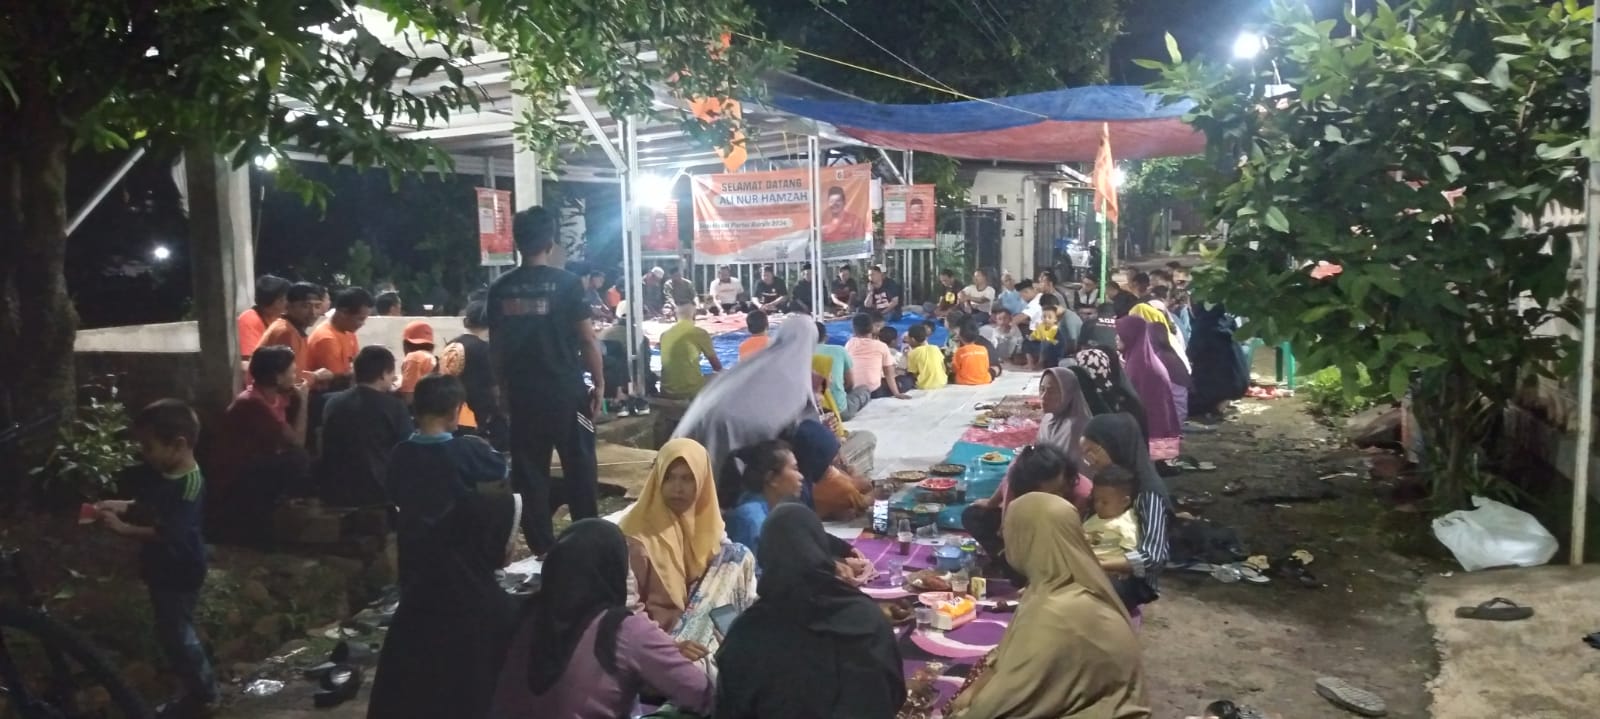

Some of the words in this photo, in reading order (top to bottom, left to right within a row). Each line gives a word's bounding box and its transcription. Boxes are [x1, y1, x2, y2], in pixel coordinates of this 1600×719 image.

[721, 180, 763, 192] SELAMAT
[766, 178, 803, 190] DATANG
[719, 194, 734, 205] ALI
[736, 193, 759, 205] NUR
[761, 191, 808, 204] HAMZAH
